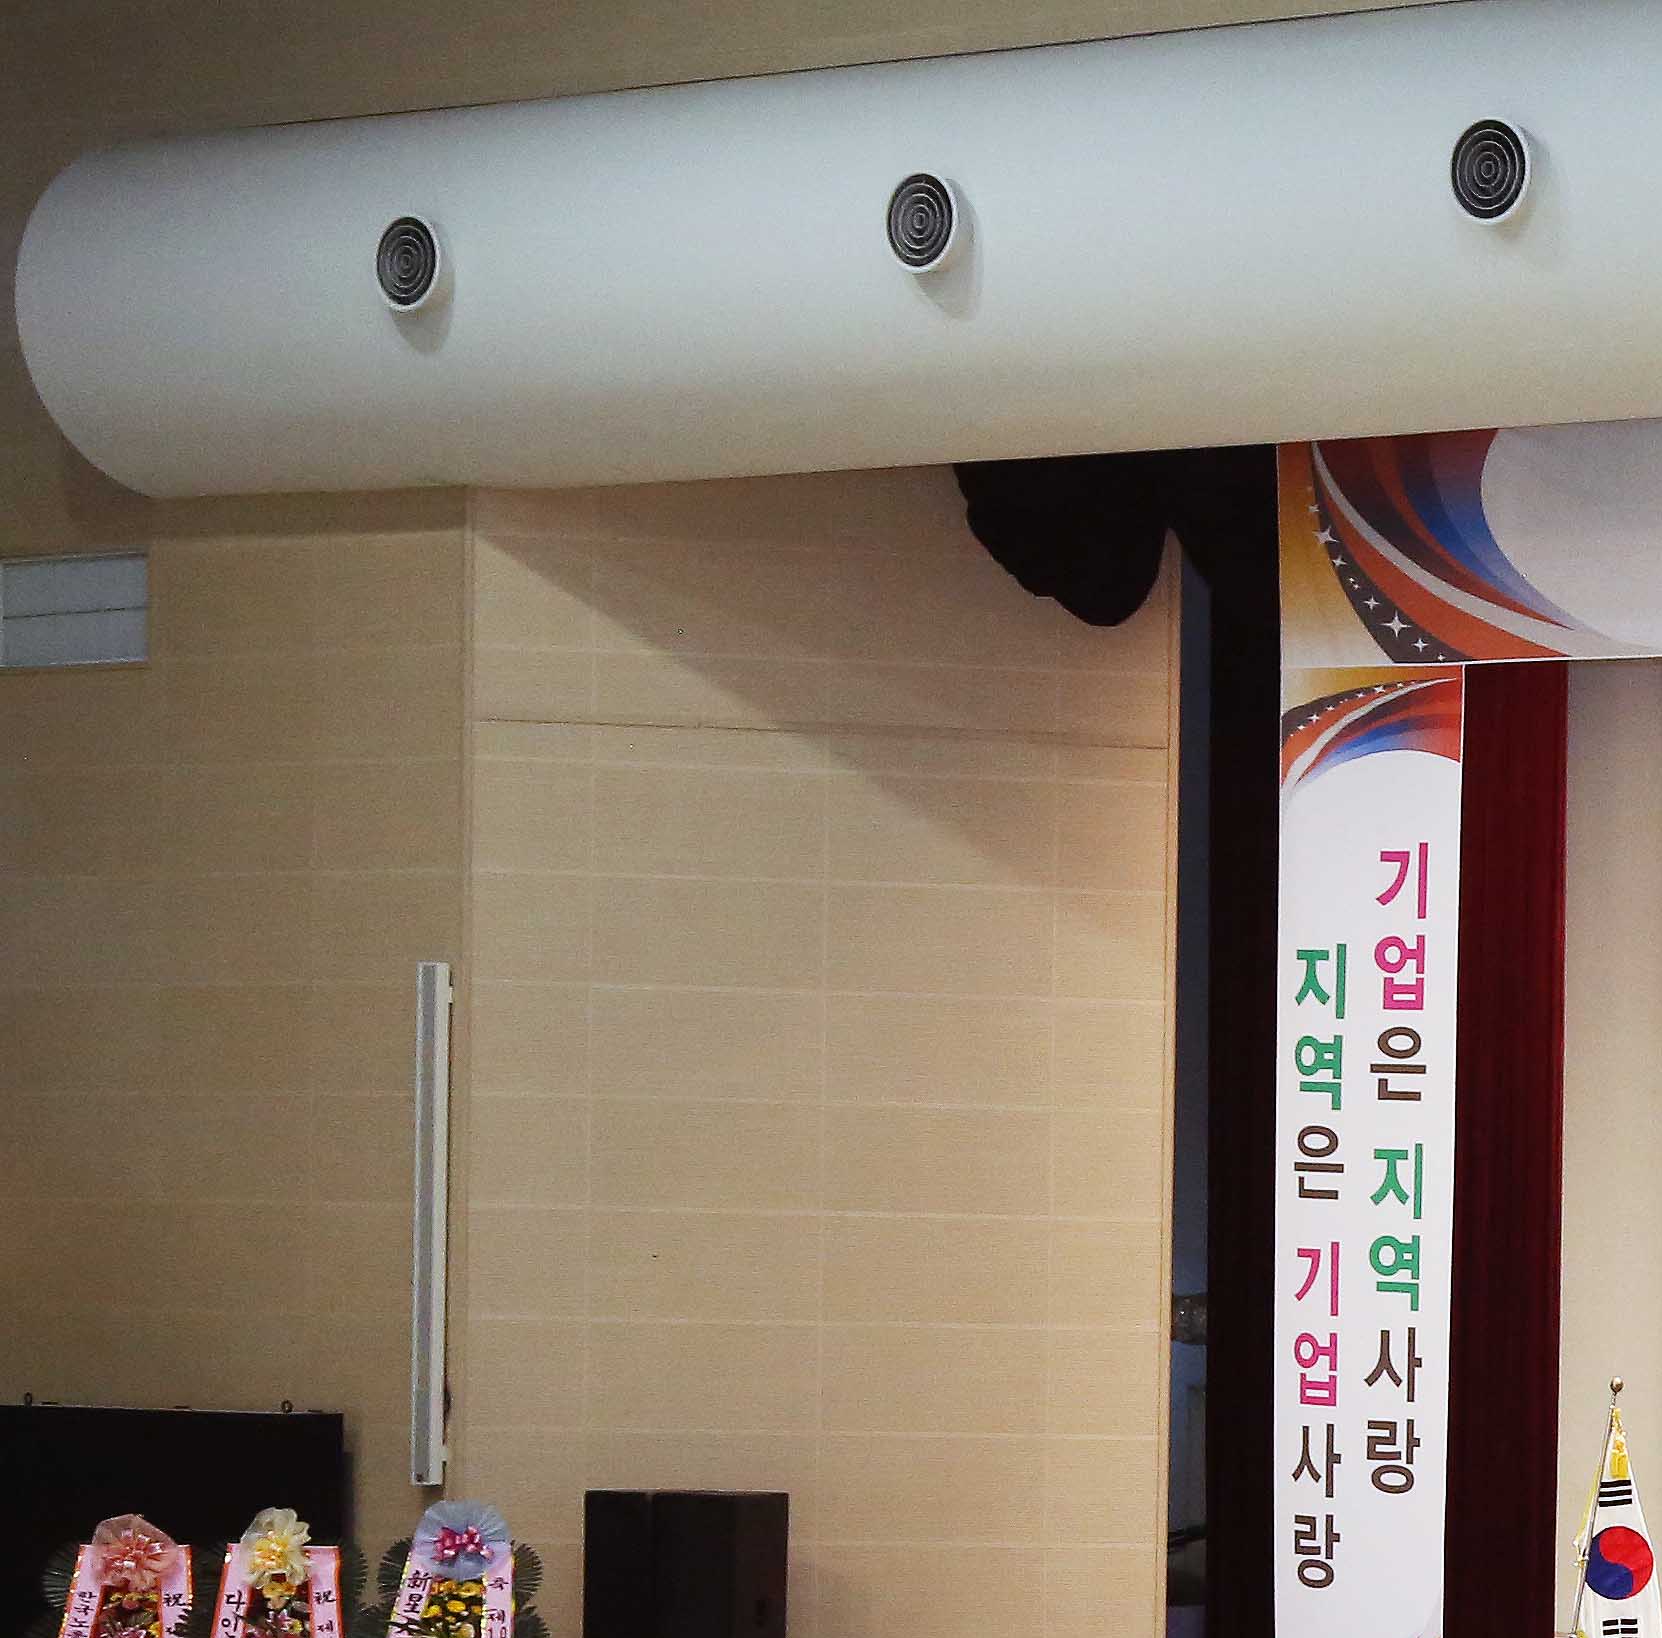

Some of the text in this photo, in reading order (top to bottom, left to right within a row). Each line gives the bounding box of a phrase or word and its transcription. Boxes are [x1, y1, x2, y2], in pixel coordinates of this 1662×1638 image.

[1291, 943, 1348, 1589] 지역은 기업사랑
[1363, 841, 1430, 1495] 기업은 지역사랑
